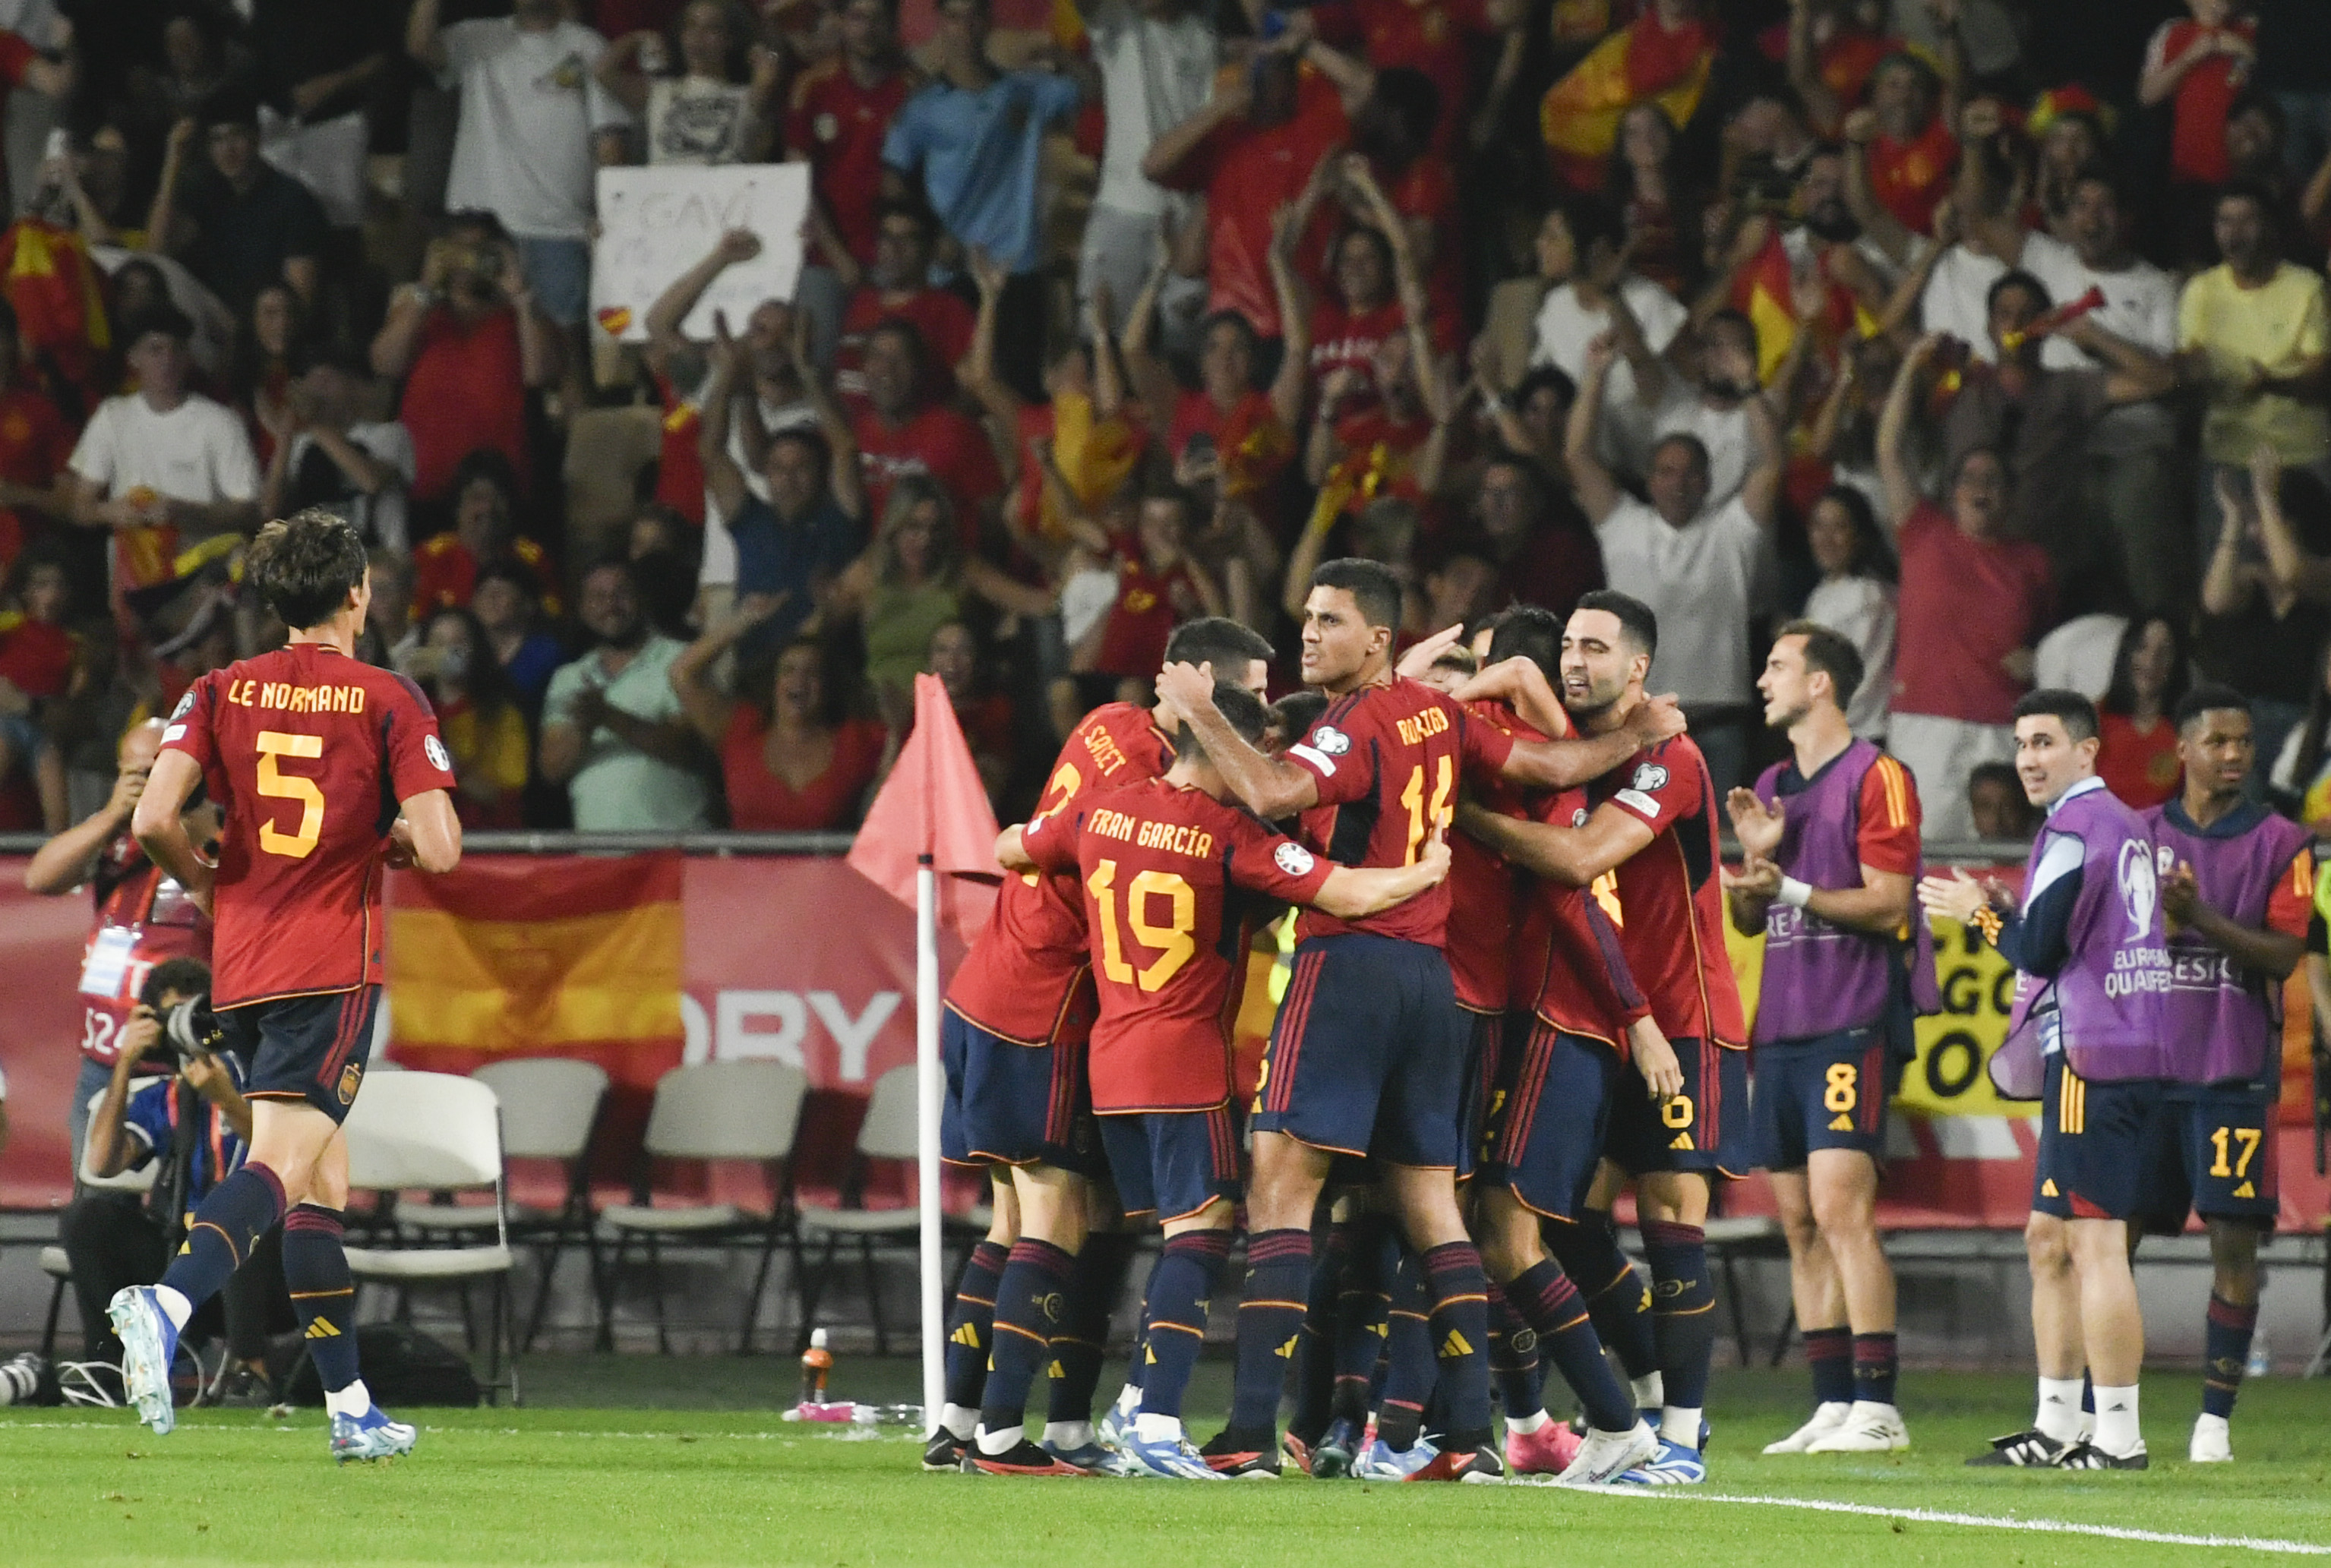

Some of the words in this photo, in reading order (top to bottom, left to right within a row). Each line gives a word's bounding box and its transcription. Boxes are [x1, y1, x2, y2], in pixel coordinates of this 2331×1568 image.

[229, 679, 257, 707] LE
[261, 682, 365, 714] NORMAND
[256, 730, 324, 859] 5
[1088, 808, 1136, 842] FRAN
[1137, 821, 1212, 859] GARCÍA
[1086, 859, 1196, 992] 19
[1824, 1063, 1857, 1112] 8
[2209, 1127, 2262, 1178] 17
